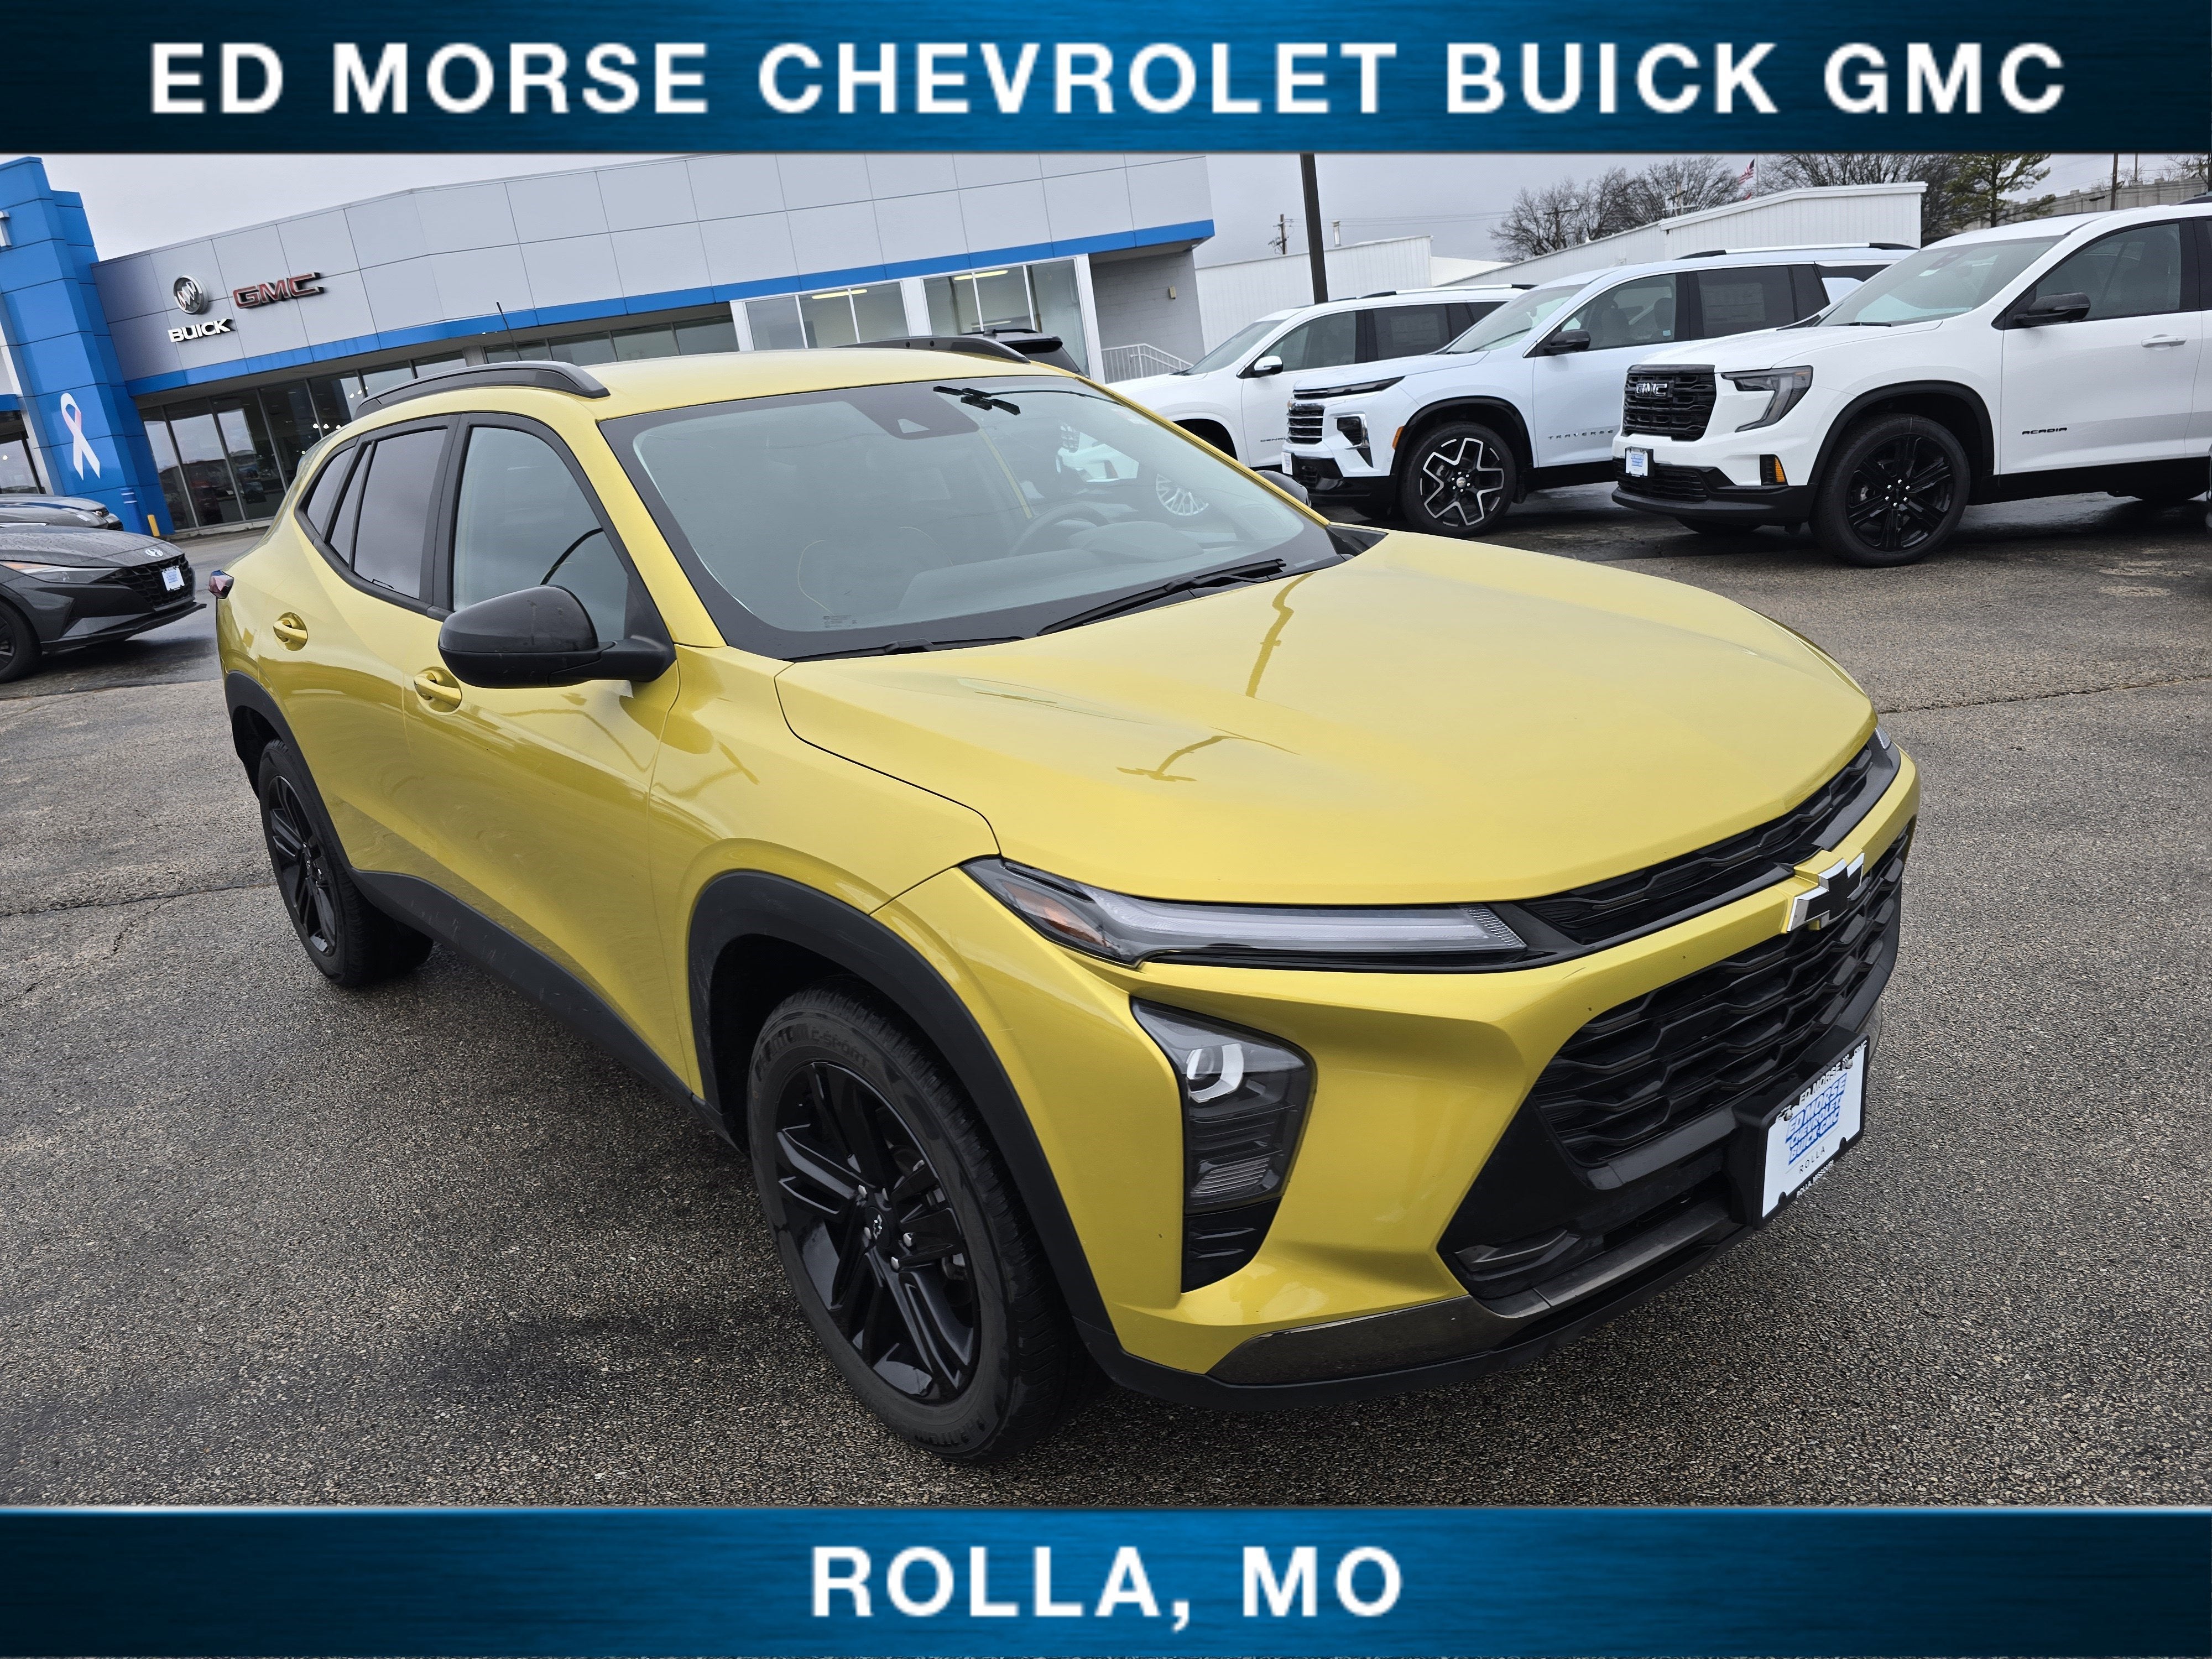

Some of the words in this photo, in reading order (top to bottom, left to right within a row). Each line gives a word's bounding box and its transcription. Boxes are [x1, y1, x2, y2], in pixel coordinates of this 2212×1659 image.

[233, 272, 321, 309] GMC
[168, 318, 231, 343] BUICK
[1636, 383, 1668, 397] GMC
[1548, 430, 1614, 440] TRAVERSE
[2022, 427, 2068, 435] ACADIA
[1787, 1109, 1806, 1137] ED
[1803, 1073, 1847, 1124] MORSE
[1790, 1094, 1840, 1149] CHEVROLET
[1799, 1146, 1825, 1173] ROLLA
